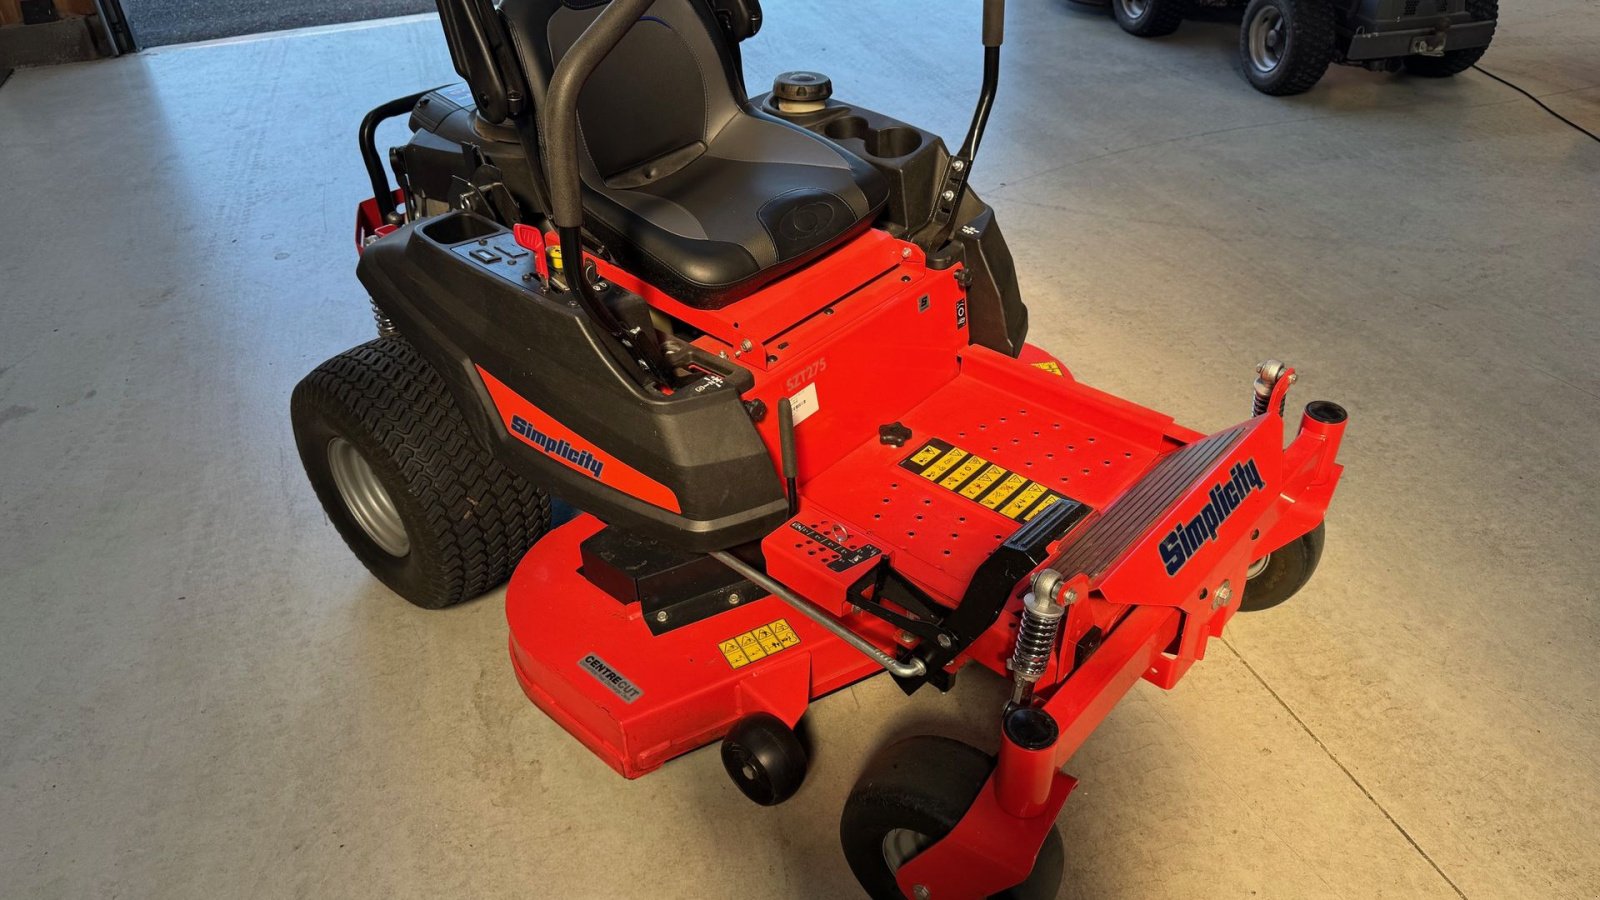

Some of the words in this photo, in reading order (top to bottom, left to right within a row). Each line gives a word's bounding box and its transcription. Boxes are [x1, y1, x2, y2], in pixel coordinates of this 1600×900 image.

[785, 357, 827, 392] SZT275
[511, 413, 604, 479] Simplicity
[1158, 458, 1266, 576] Simplicity
